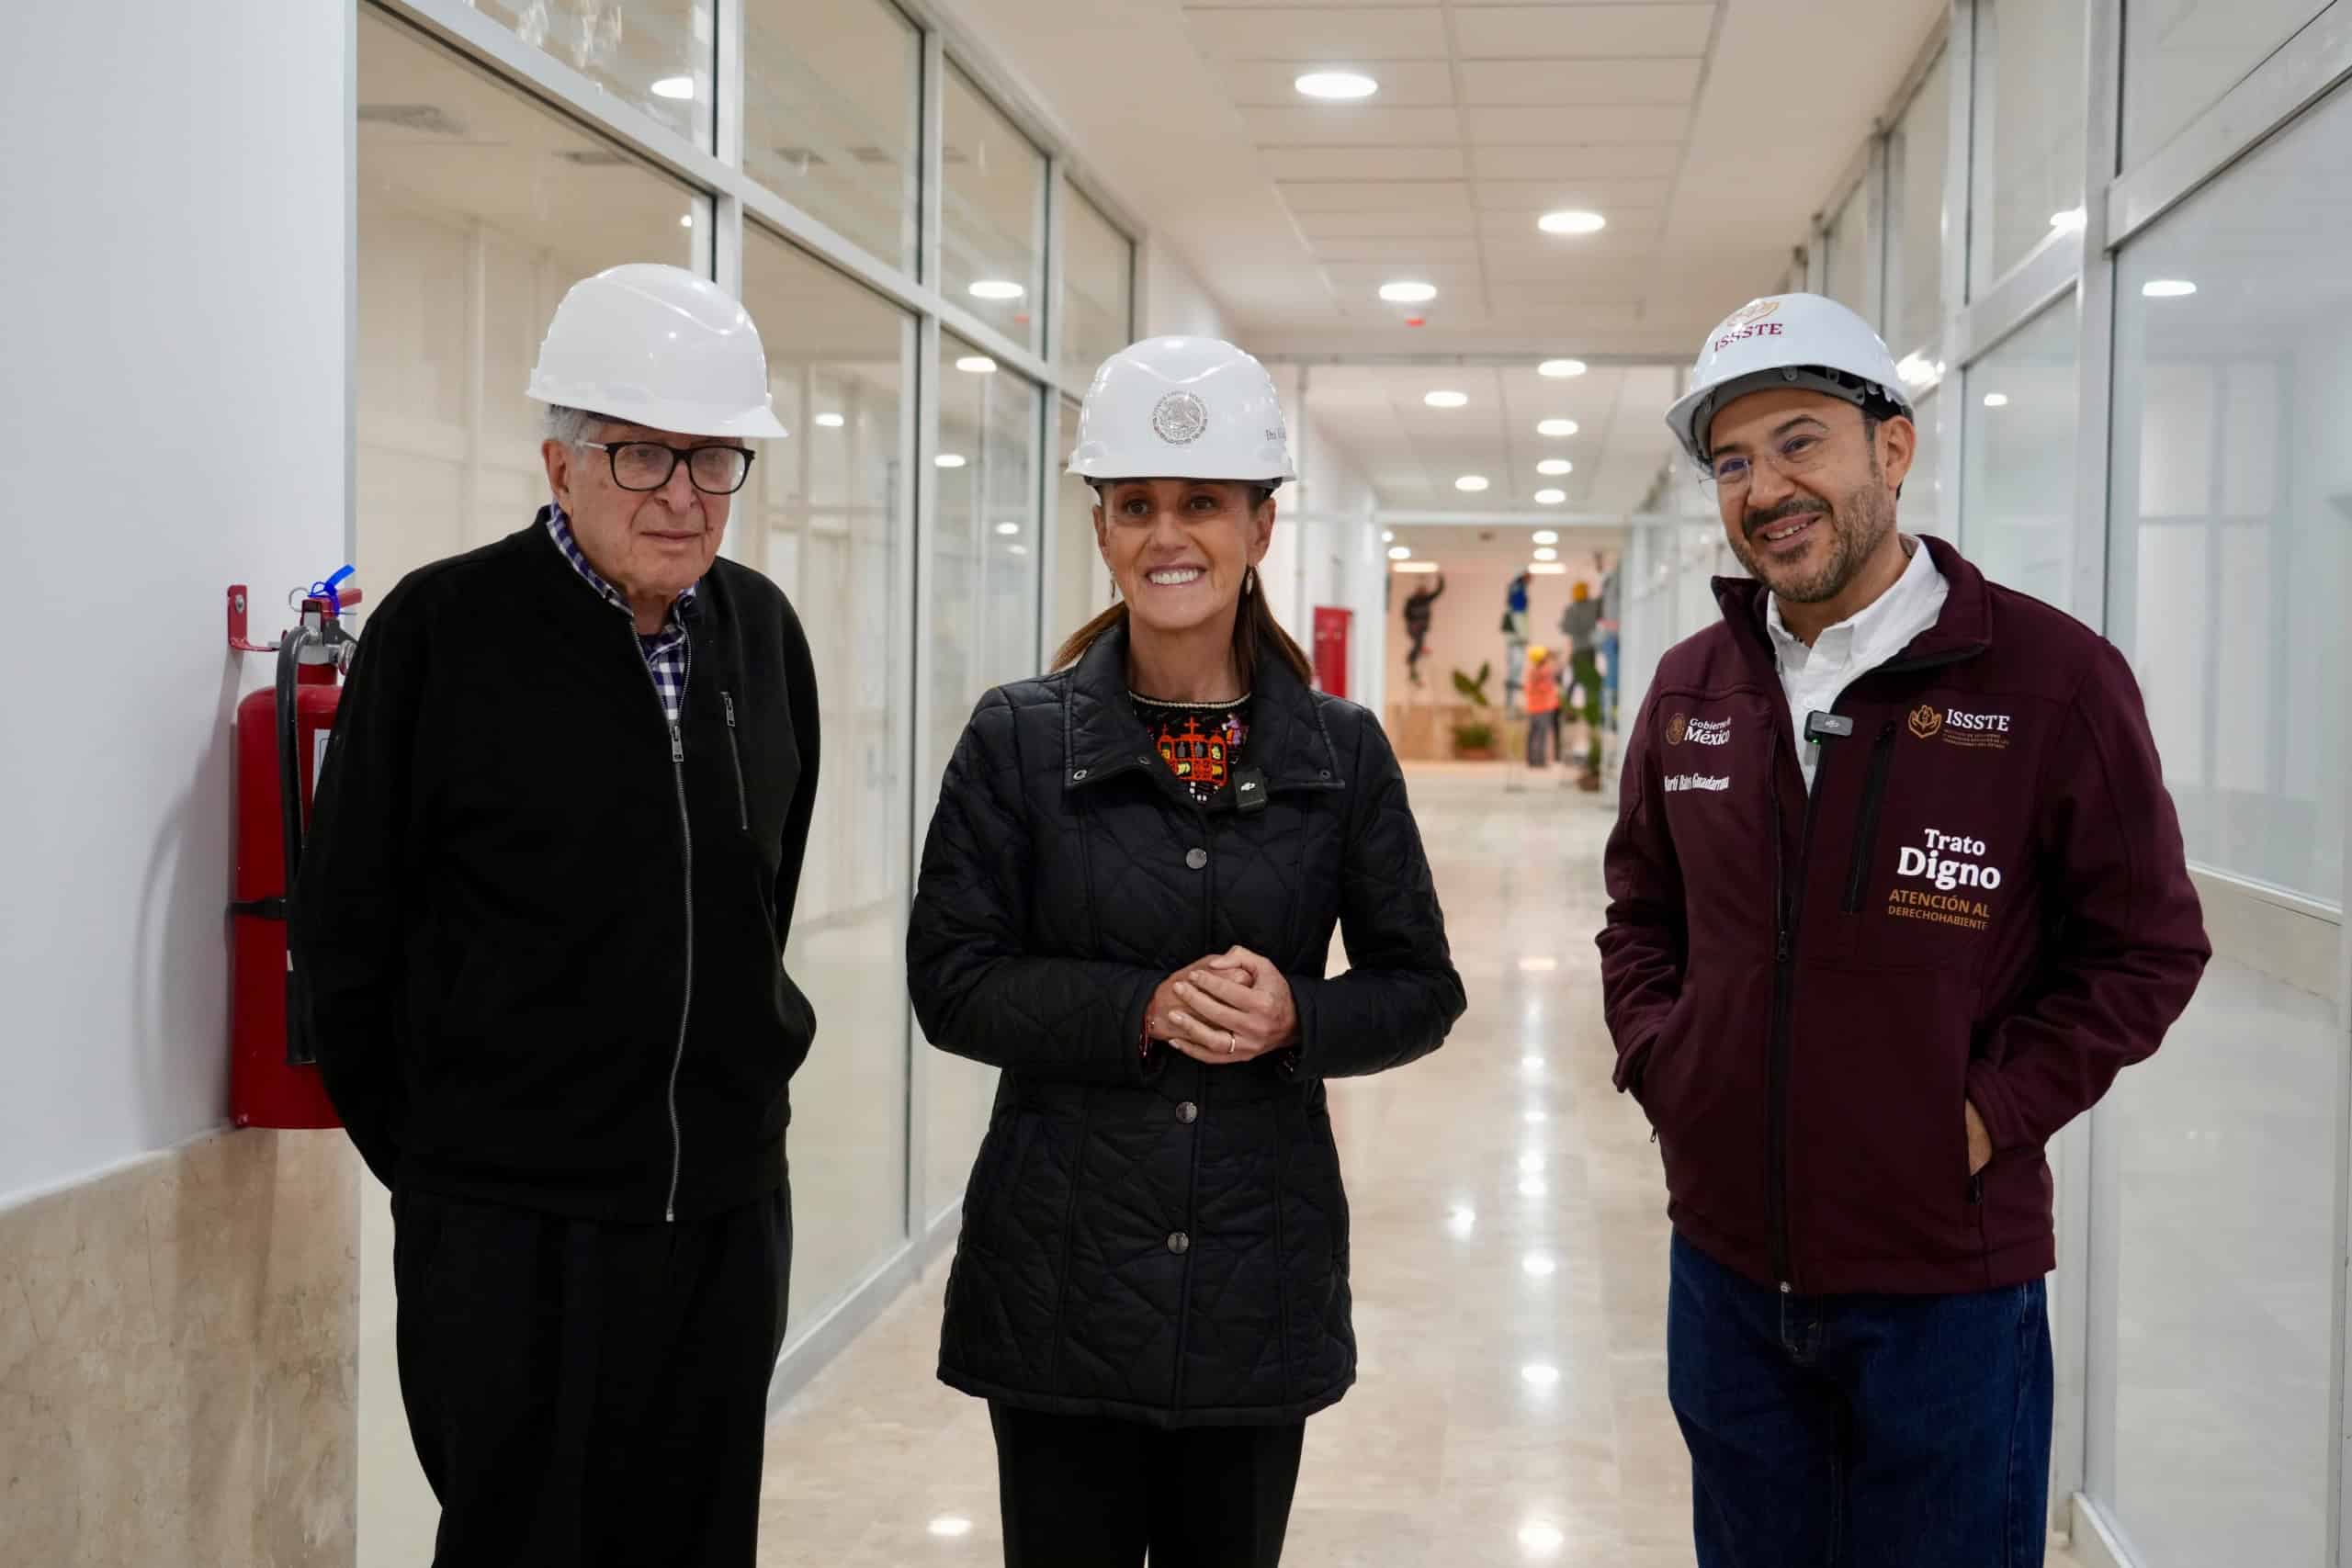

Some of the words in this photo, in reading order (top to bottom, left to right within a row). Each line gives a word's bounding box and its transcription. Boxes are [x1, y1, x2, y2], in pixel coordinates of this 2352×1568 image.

[1714, 322, 1783, 352] ISSSTE
[1945, 708, 2010, 731] ISSSTE
[1925, 829, 1985, 856] Trato
[1896, 846, 2001, 890] Digno
[1889, 888, 1970, 913] ATENCIÓN
[1973, 903, 1990, 918] AL
